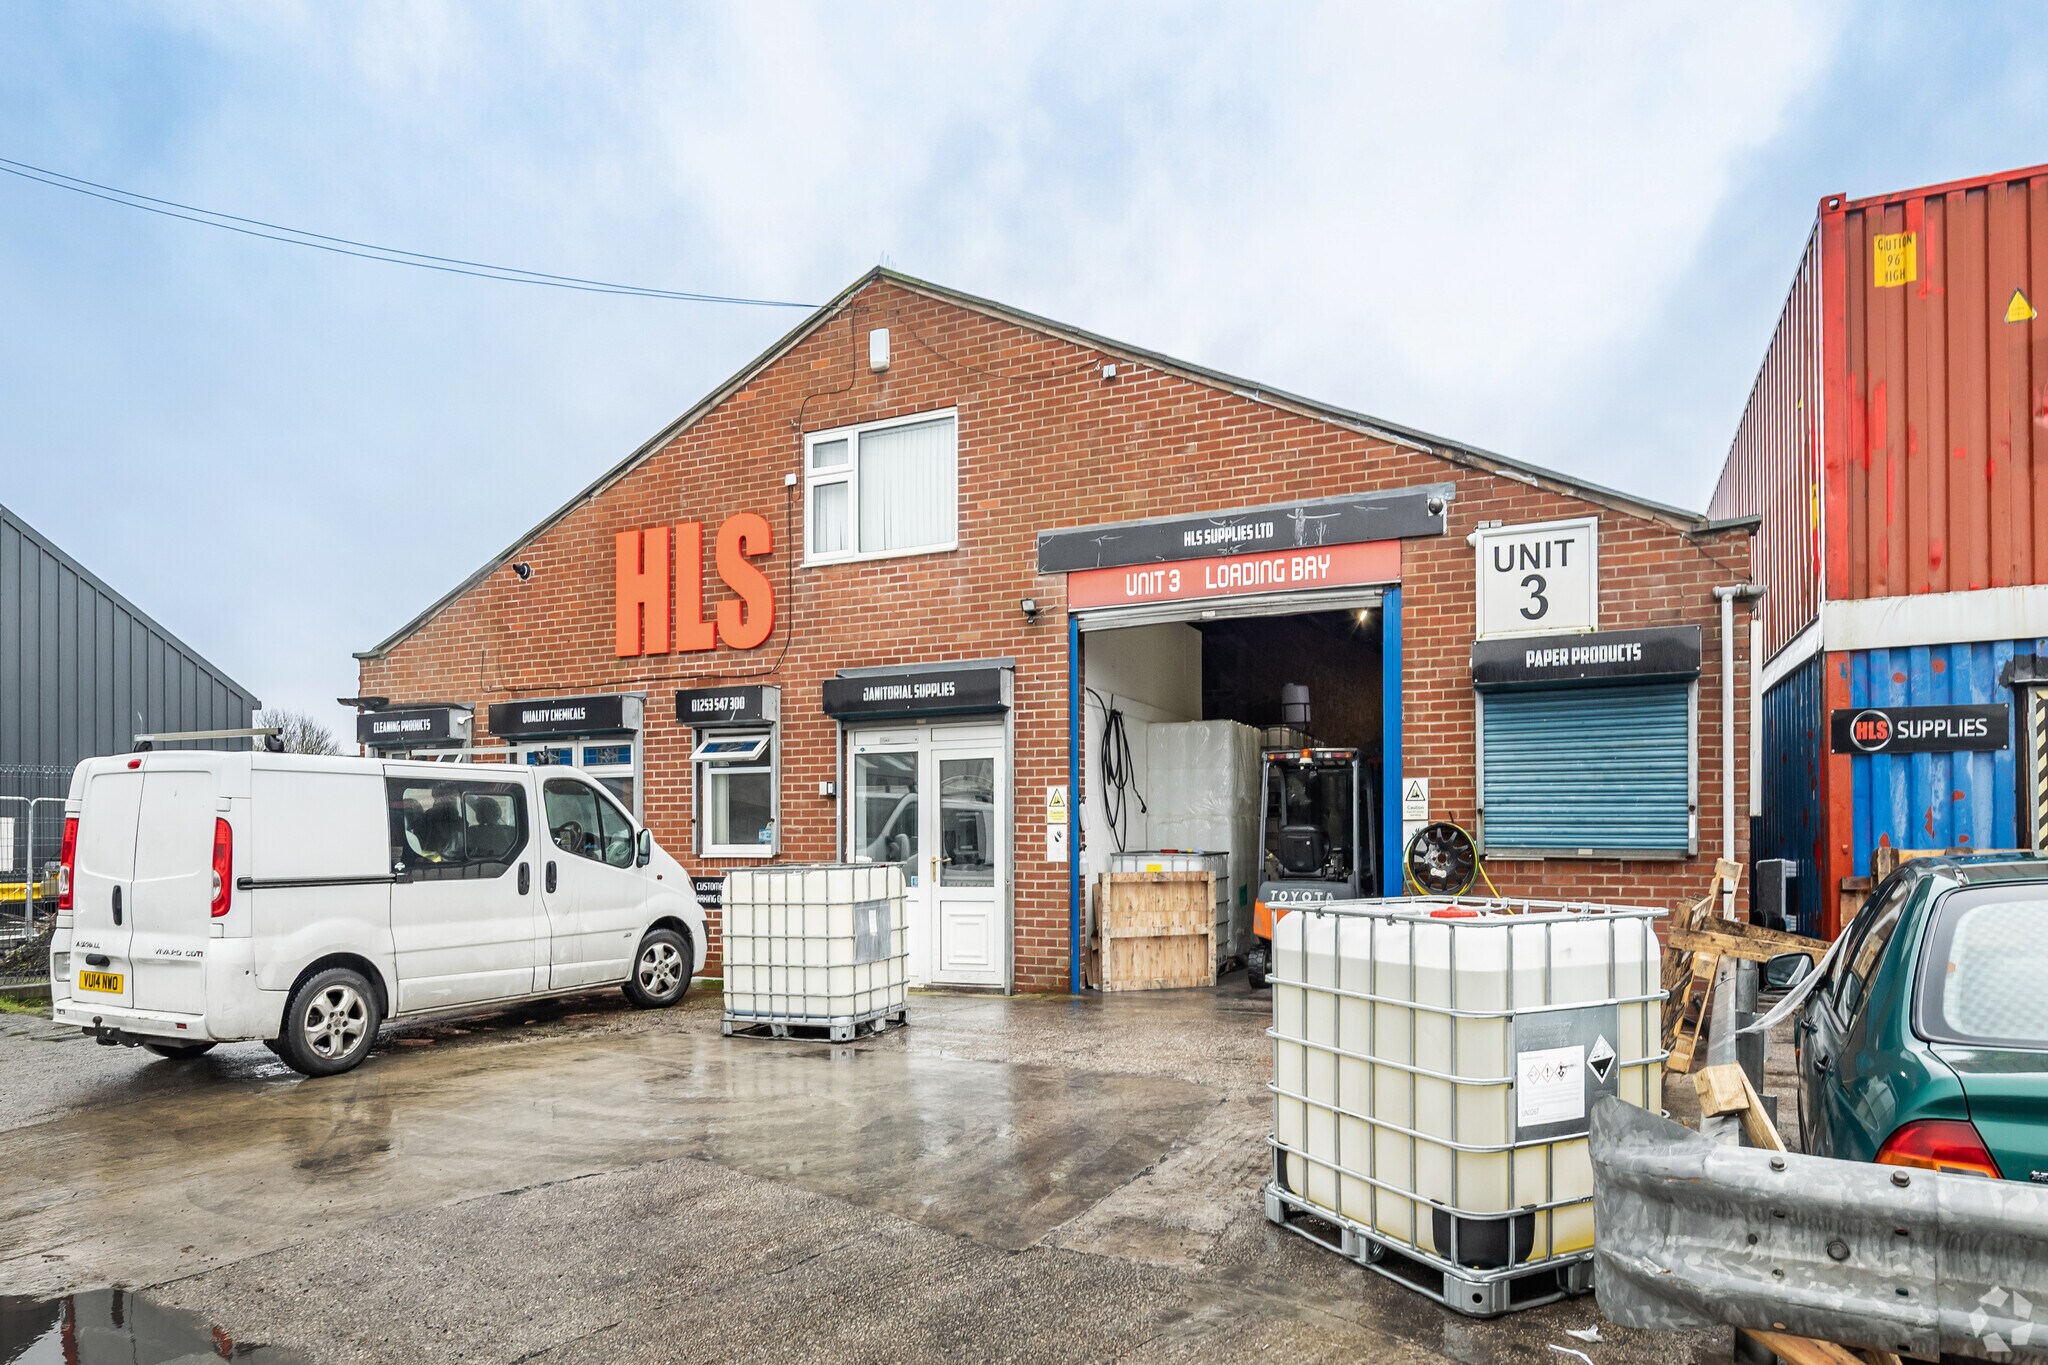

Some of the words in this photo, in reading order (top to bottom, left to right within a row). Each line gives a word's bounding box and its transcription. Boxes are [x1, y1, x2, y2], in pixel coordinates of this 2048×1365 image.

[1878, 234, 1912, 251] CUTION
[1184, 530, 1202, 547] HLS
[1204, 524, 1254, 544] SUPPLIES
[1254, 522, 1274, 539] LTD
[1494, 538, 1575, 572] UNIT
[616, 512, 775, 656] HLS
[1126, 570, 1165, 596] UNIT
[1168, 569, 1180, 592] 3
[1206, 558, 1285, 590] LOADING
[1292, 554, 1330, 582] BAY
[1520, 574, 1549, 620] 3
[1526, 648, 1568, 668] PAPER
[1572, 643, 1642, 666] PRODUCTS
[863, 684, 912, 702] JANITORIAL
[914, 682, 956, 700] SUPPLIES
[692, 697, 714, 712] 01253
[714, 696, 728, 711] 547
[730, 696, 745, 710] 300
[522, 709, 550, 724] QUALITY
[550, 707, 586, 722] CHEMICALS
[374, 720, 400, 734] CLEANING
[400, 718, 430, 732] PRODUCTS
[1856, 721, 1888, 740] HLS
[1898, 718, 1988, 740] SUPPLIES
[696, 882, 723, 891] CUSTOME
[1270, 890, 1334, 902] TOYOTA
[697, 894, 716, 903] ARKING
[84, 972, 100, 988] VU14
[102, 974, 118, 991] NWO
